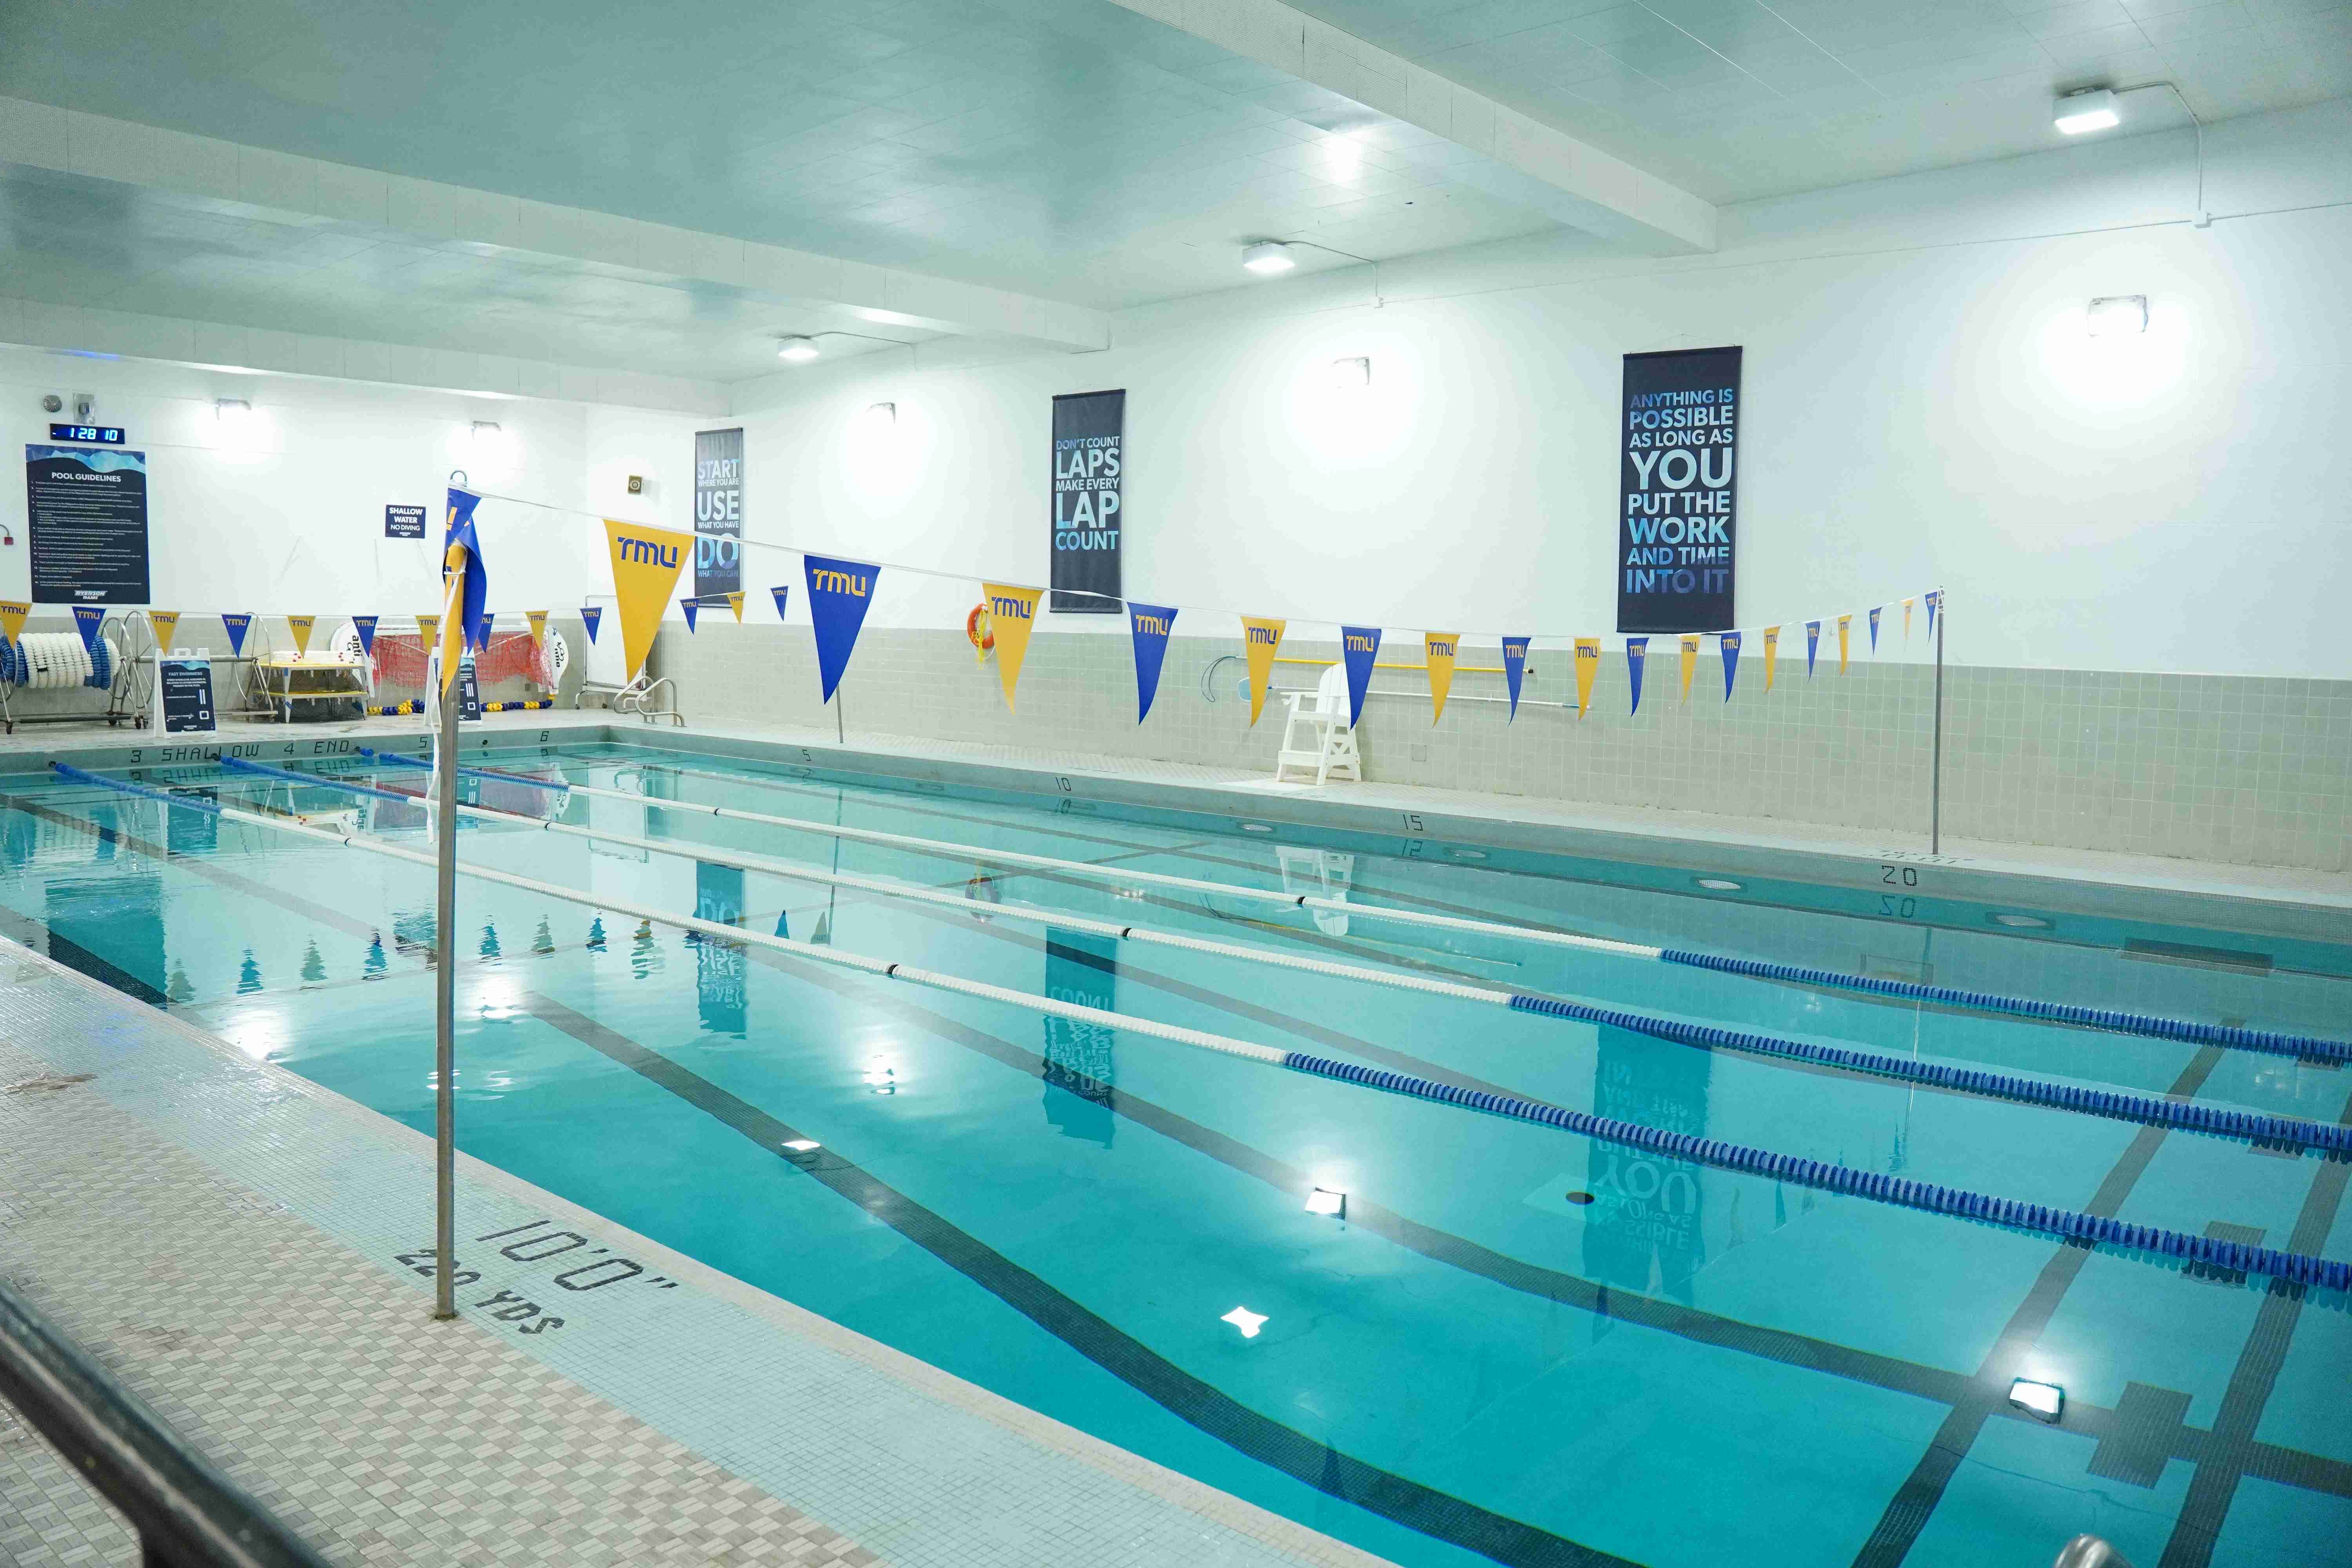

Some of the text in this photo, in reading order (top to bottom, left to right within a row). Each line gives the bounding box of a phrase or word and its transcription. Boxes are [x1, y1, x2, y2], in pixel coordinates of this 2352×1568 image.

[1630, 388, 1733, 408] ANYTHING IS
[1630, 405, 1733, 430] POSSIBLE
[1056, 436, 1120, 450] DON'T COUNT
[1629, 428, 1733, 448] AS LONG AS
[697, 459, 740, 479] START
[1056, 447, 1120, 479] LAPS
[1629, 447, 1733, 490] YOU
[75, 474, 121, 482] GUIDELINES
[697, 479, 716, 487] WHERE
[1056, 477, 1119, 492] MAKE EVERY
[697, 490, 739, 521] USE
[1056, 490, 1120, 529] LAP
[1628, 491, 1730, 515] PUT THE
[1628, 516, 1730, 544] WORK
[1055, 530, 1118, 550] COUNT
[618, 537, 678, 569] TMU
[697, 533, 739, 569] DO
[1626, 546, 1729, 565] AND TIME
[813, 568, 866, 597] TMU
[1626, 568, 1729, 593] INTO IT
[1, 606, 26, 615] TMU
[78, 610, 101, 619] TMU
[991, 596, 1032, 619] TMU
[154, 615, 175, 623] TMU
[1135, 614, 1169, 636] TMU
[1248, 627, 1278, 645] TMU
[1346, 635, 1374, 652] TMU
[1722, 638, 1739, 650] TMU
[1766, 633, 1777, 644] TMU
[1430, 642, 1455, 656] TMU
[1505, 644, 1526, 659] TMU
[1577, 646, 1598, 659] TMU
[1629, 644, 1644, 658] TMU
[1682, 642, 1696, 652] TMU
[131, 731, 549, 763] 3 SHALLOW 4 END 5 6
[802, 749, 811, 761] 5
[1055, 777, 1071, 791] 10
[1403, 814, 1423, 831] 15
[1882, 865, 1917, 886] 20
[475, 1290, 564, 1334] YDS
